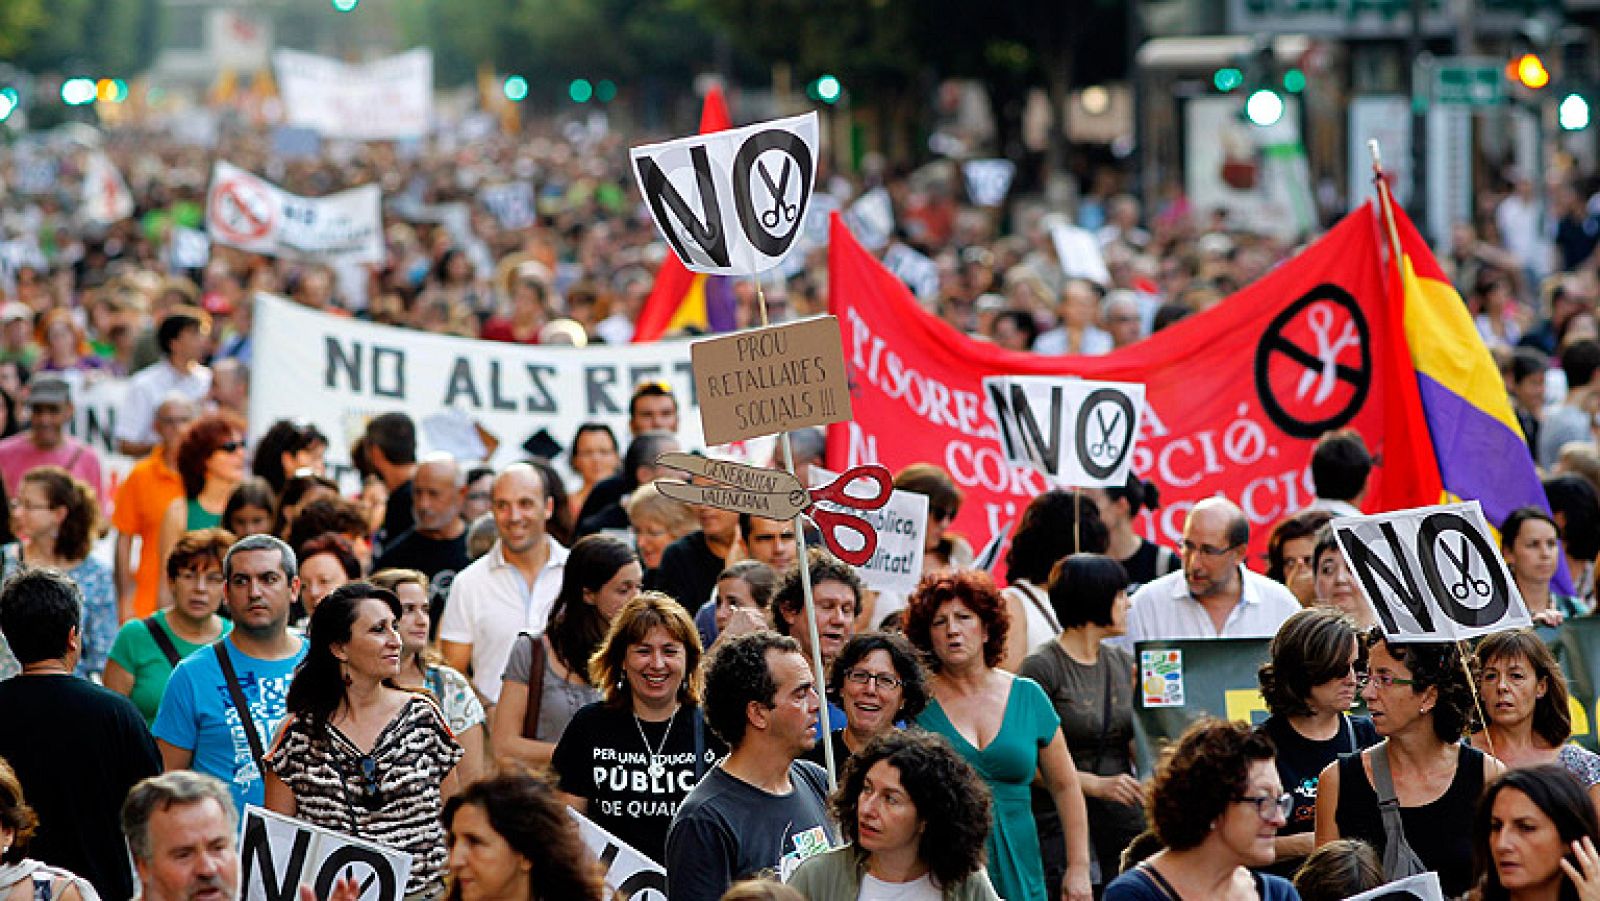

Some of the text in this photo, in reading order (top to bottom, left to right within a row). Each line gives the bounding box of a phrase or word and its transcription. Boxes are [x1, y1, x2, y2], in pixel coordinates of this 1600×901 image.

[635, 129, 813, 267] NO
[736, 331, 787, 362] PROU
[325, 336, 405, 398] NO
[444, 356, 557, 413] ALS
[707, 356, 827, 397] RETALLADES
[735, 391, 813, 430] SOCIALS
[1008, 383, 1136, 481] NO
[703, 462, 778, 493] GENERALITAT
[701, 489, 770, 511] VALENCIANA
[1337, 512, 1509, 635] NO
[593, 747, 715, 766] PER UNA EDUCAÓ
[593, 764, 696, 794] PÚBLIC
[241, 811, 396, 901] NO
